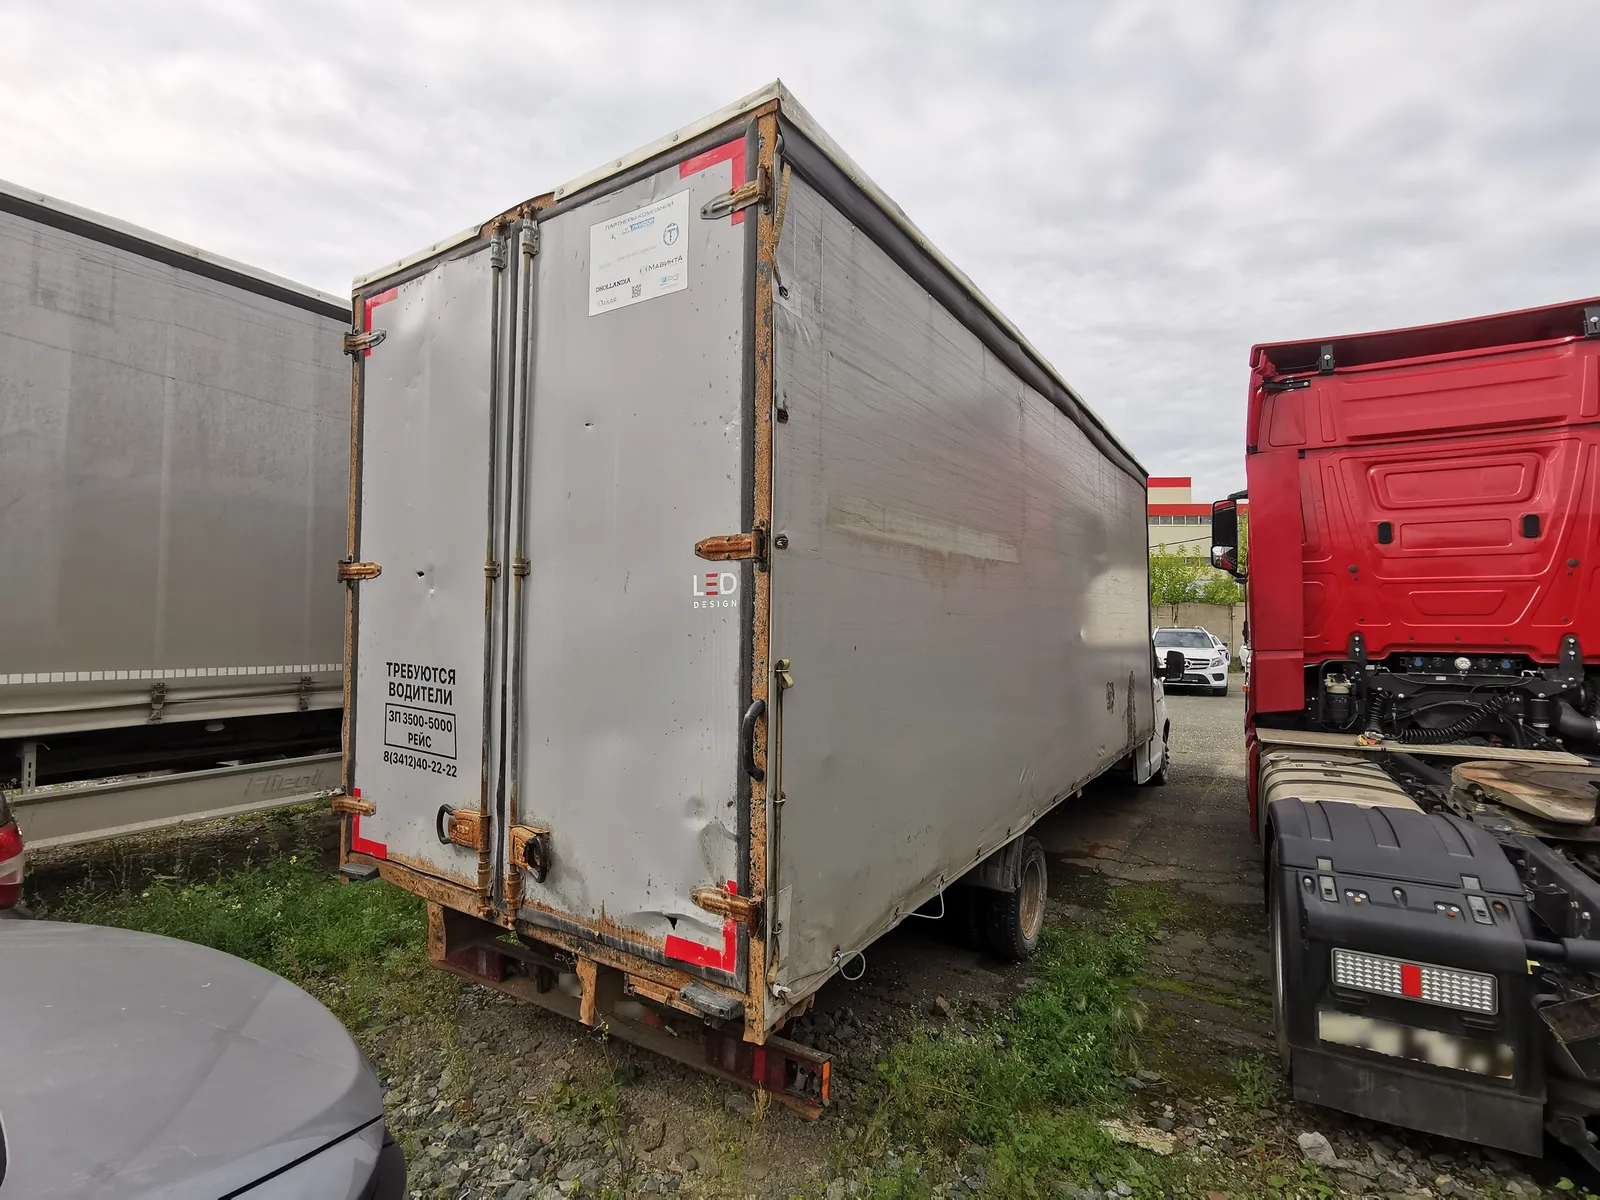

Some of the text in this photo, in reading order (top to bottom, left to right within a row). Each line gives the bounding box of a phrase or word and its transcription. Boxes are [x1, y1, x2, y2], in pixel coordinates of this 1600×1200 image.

[604, 215, 637, 231] ПАРТНЕРЫ
[595, 277, 631, 293] DHOLLANDIA
[693, 572, 738, 597] LED
[693, 599, 737, 609] DESIGN
[386, 661, 456, 686] ТРЕБУЮТСЯ
[388, 681, 453, 706] ВОДИТЕЛИ
[402, 712, 453, 733] 3500-5000
[408, 731, 432, 749] РЕЙС
[383, 750, 458, 778] 8(3412)40-22-22
